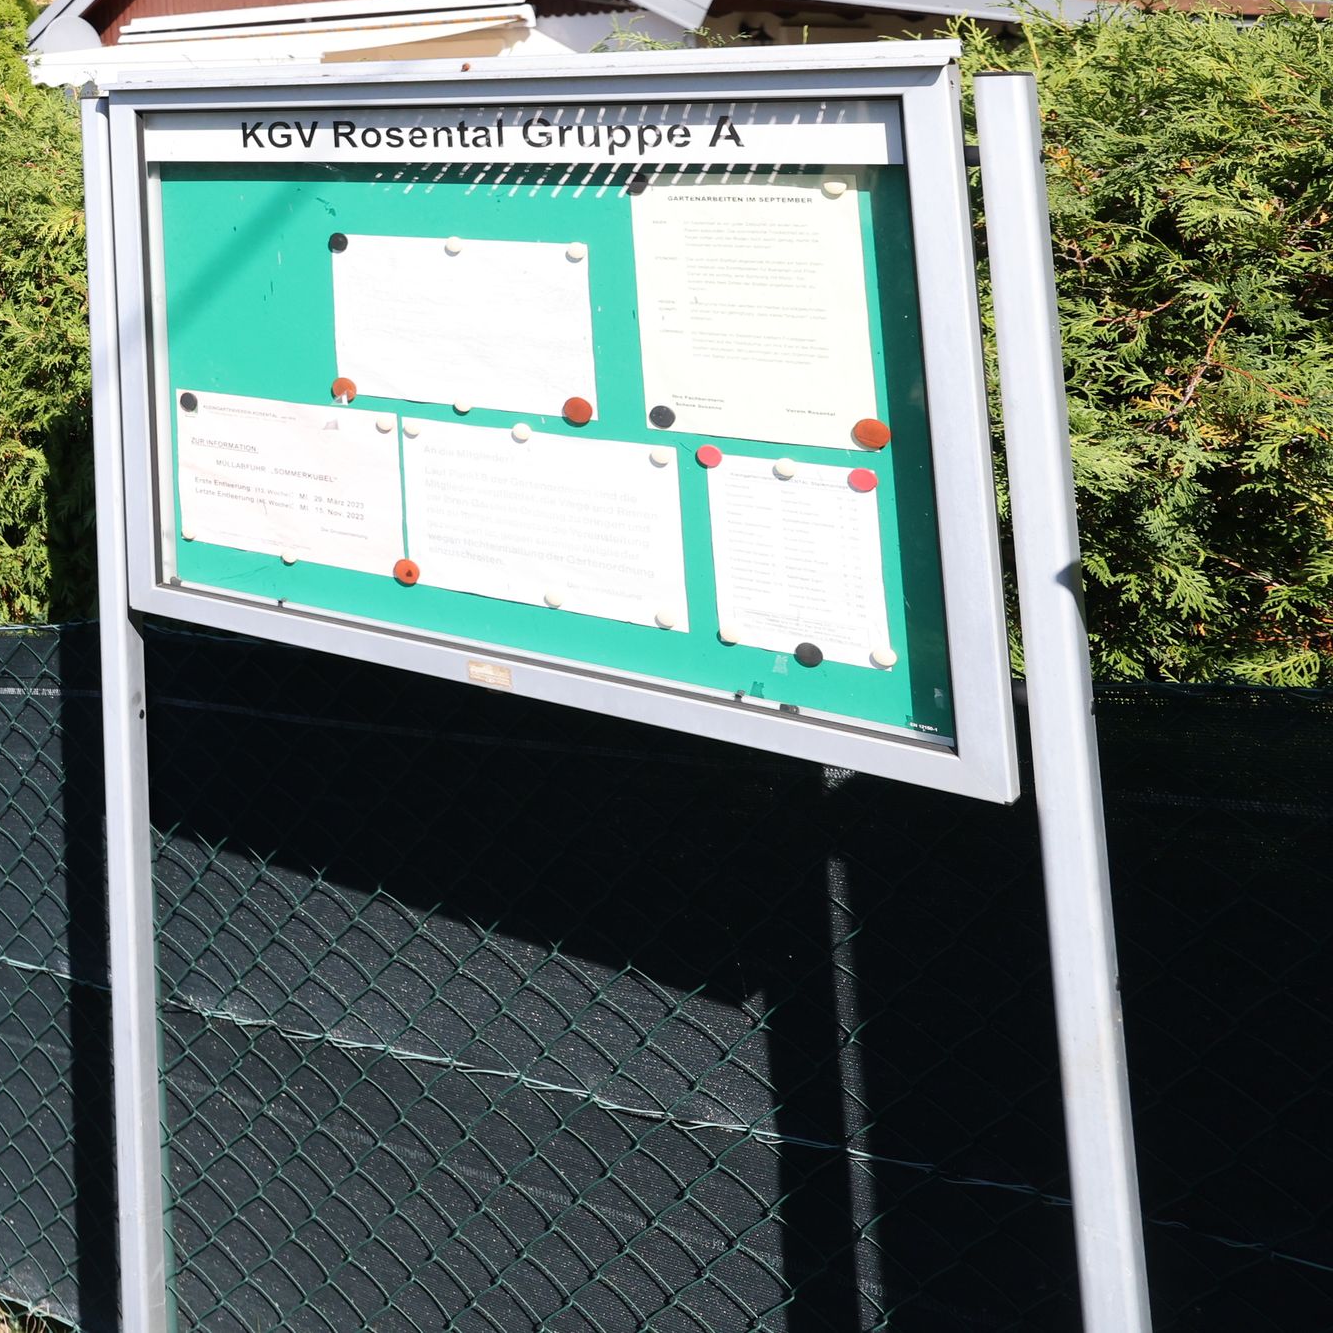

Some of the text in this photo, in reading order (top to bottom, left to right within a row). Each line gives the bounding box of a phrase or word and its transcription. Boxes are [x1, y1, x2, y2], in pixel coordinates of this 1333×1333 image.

[241, 115, 745, 156] KGV Rosental Gruppe A
[191, 437, 257, 452] ZUR INFORMATION
[195, 477, 212, 485] Erste
[214, 479, 251, 492] Entleerung
[347, 500, 364, 509] 2023
[217, 491, 254, 504] Entleerung
[347, 511, 364, 520] 2023
[566, 555, 655, 578] Gartenordnung
